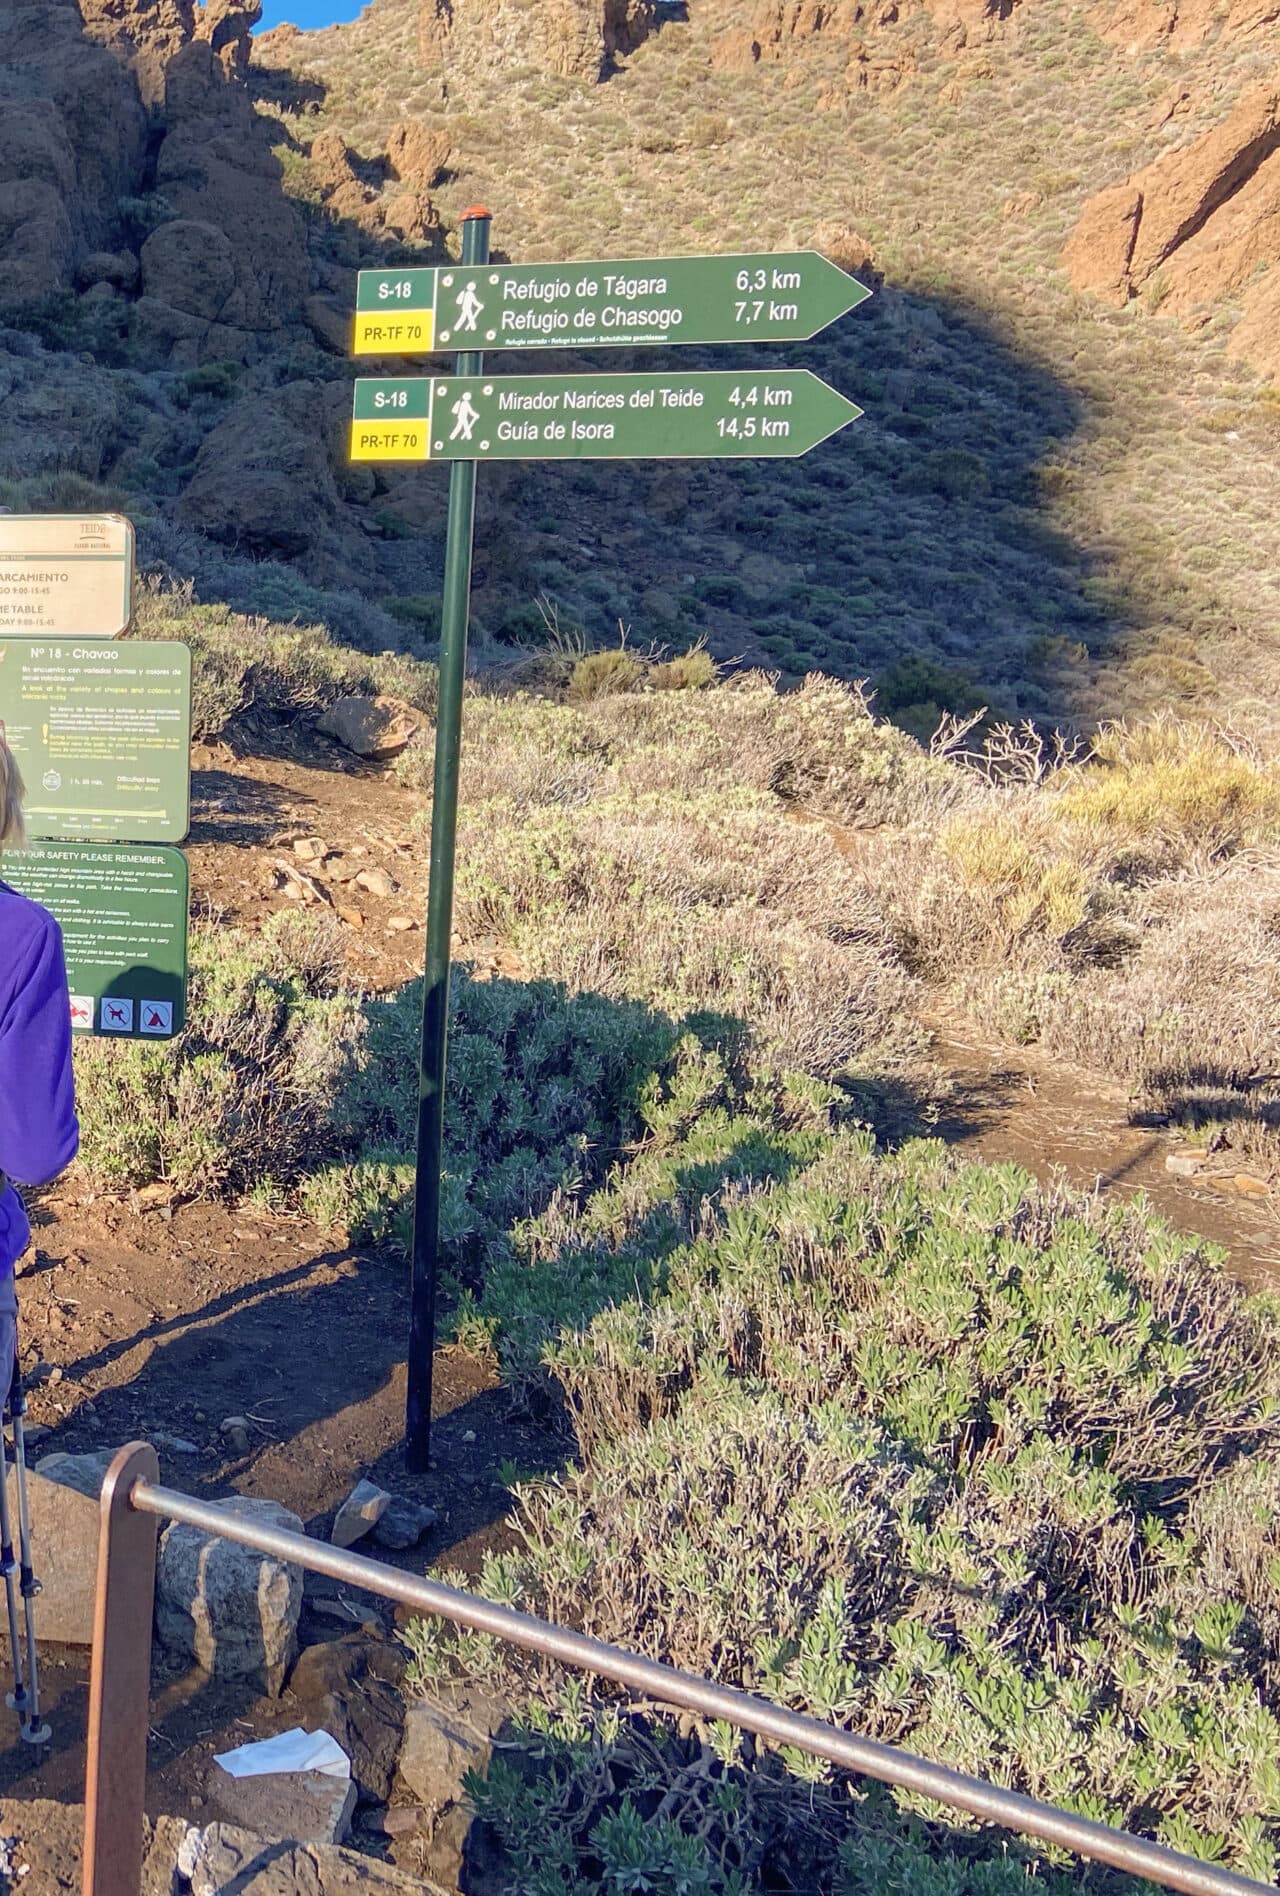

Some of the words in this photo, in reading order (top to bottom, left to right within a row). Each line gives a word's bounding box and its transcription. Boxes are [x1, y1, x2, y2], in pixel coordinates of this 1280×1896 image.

[378, 282, 412, 299] S-18
[503, 279, 571, 303] Refugio
[575, 277, 598, 297] de
[603, 275, 667, 300] Tágara
[736, 269, 766, 293] 6,3
[772, 269, 801, 289] km
[501, 309, 568, 333] Refugio
[573, 308, 596, 327] de
[601, 306, 683, 329] Chasogo
[734, 301, 764, 325] 7,7
[769, 300, 798, 321] km
[364, 326, 403, 340] PR-TF
[407, 325, 421, 339] 70
[374, 391, 408, 408] S-18
[498, 392, 559, 410] Mirador
[563, 391, 625, 409] Narices
[629, 389, 654, 408] del
[659, 388, 704, 408] Teide
[728, 386, 758, 409] 4,4
[764, 386, 792, 406] km
[497, 421, 538, 440] Guía
[543, 421, 566, 439] de
[571, 420, 614, 439] Isora
[716, 417, 756, 440] 14,5
[761, 417, 790, 437] km
[360, 435, 400, 448] PR-TF
[403, 434, 418, 447] 70
[12, 605, 44, 614] TABLE
[48, 647, 62, 660] 18
[72, 648, 119, 660] Chavao
[21, 849, 46, 859] YOUR
[47, 851, 80, 861] SAFETY
[81, 853, 114, 862] PLEASE
[115, 854, 166, 865] REMEMBER:
